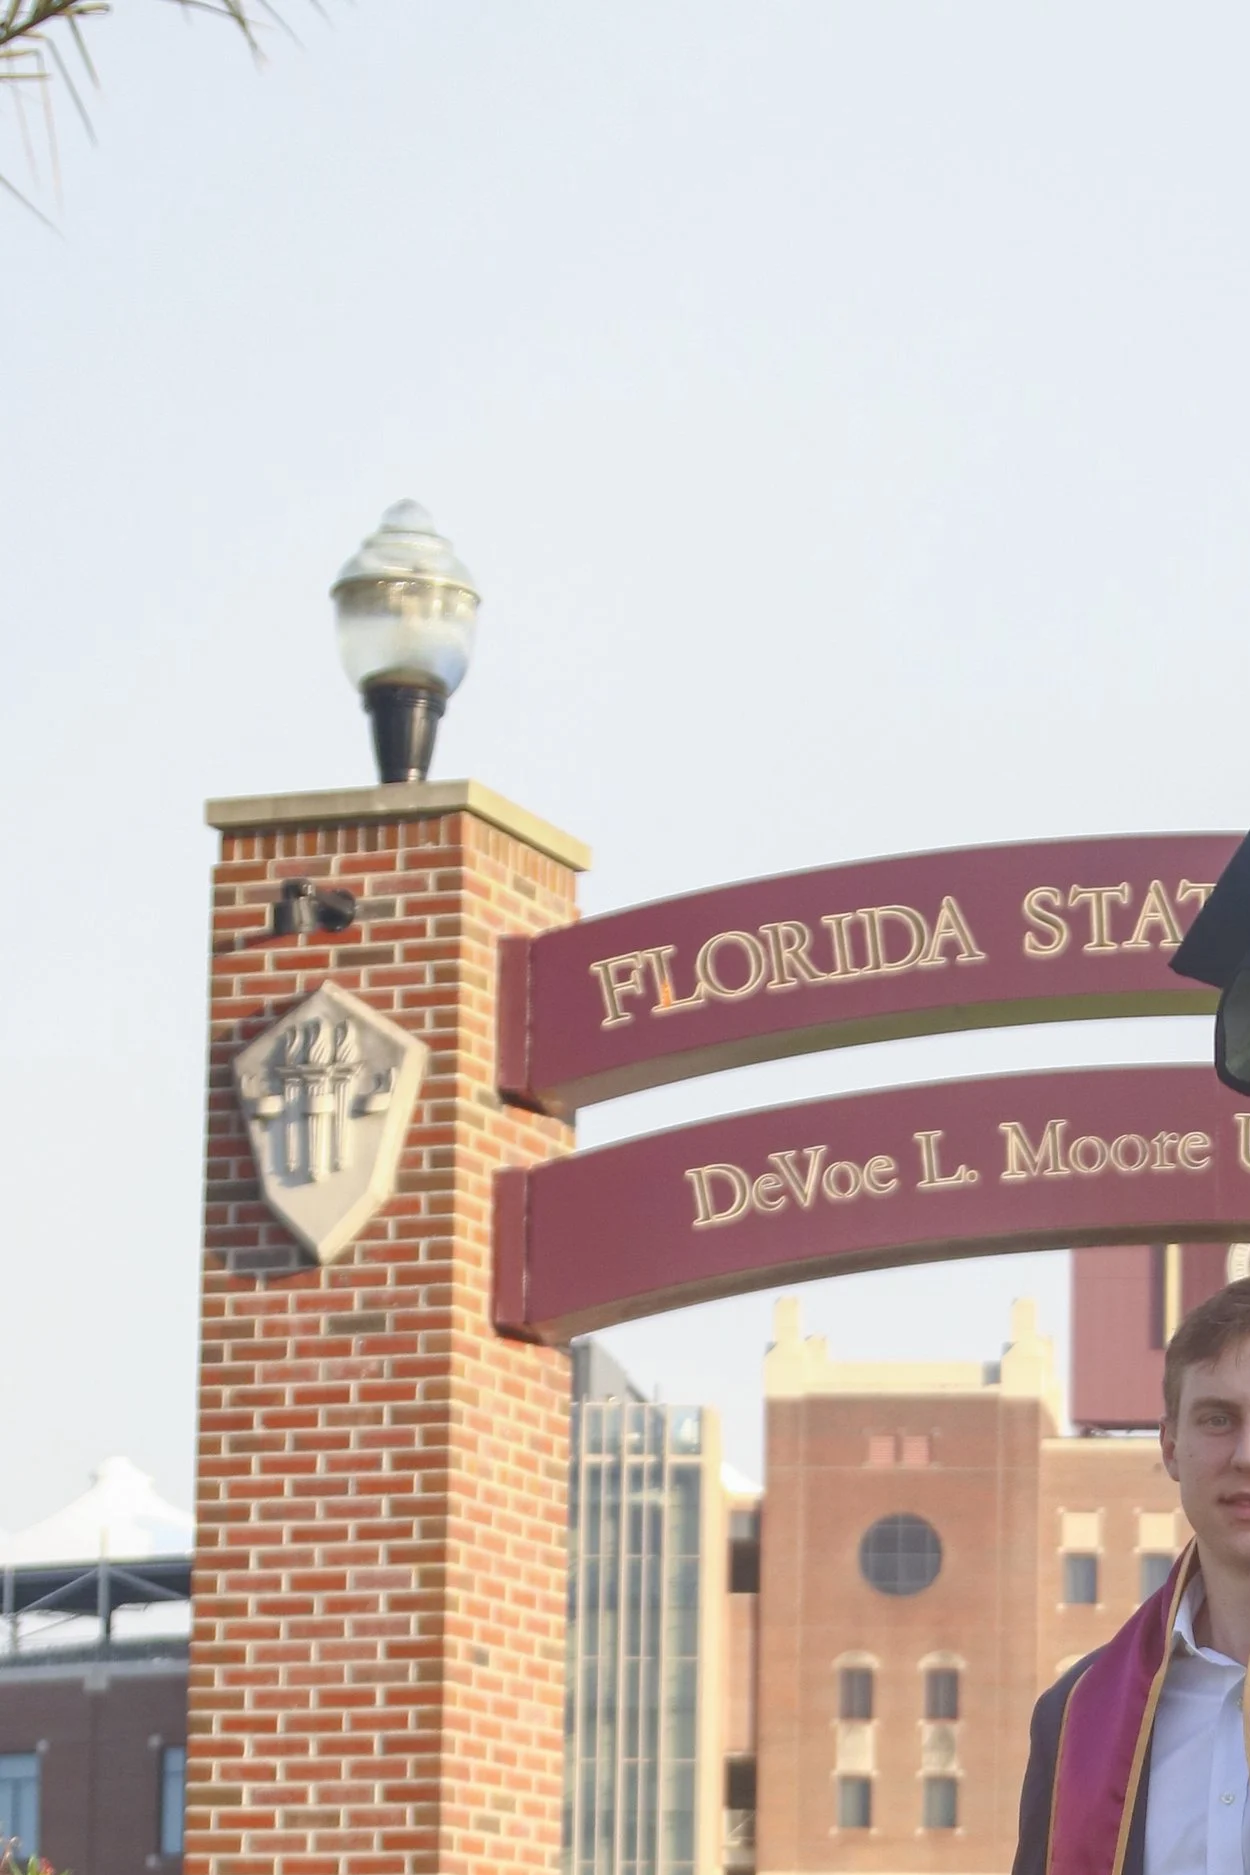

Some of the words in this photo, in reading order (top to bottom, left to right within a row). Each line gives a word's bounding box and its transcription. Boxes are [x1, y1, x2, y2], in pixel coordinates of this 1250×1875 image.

[592, 896, 986, 1027] FLORIDA
[1022, 879, 1217, 956] STA
[686, 1146, 897, 1228] DeVoe
[915, 1131, 978, 1188] L.
[1000, 1120, 1211, 1178] Moore
